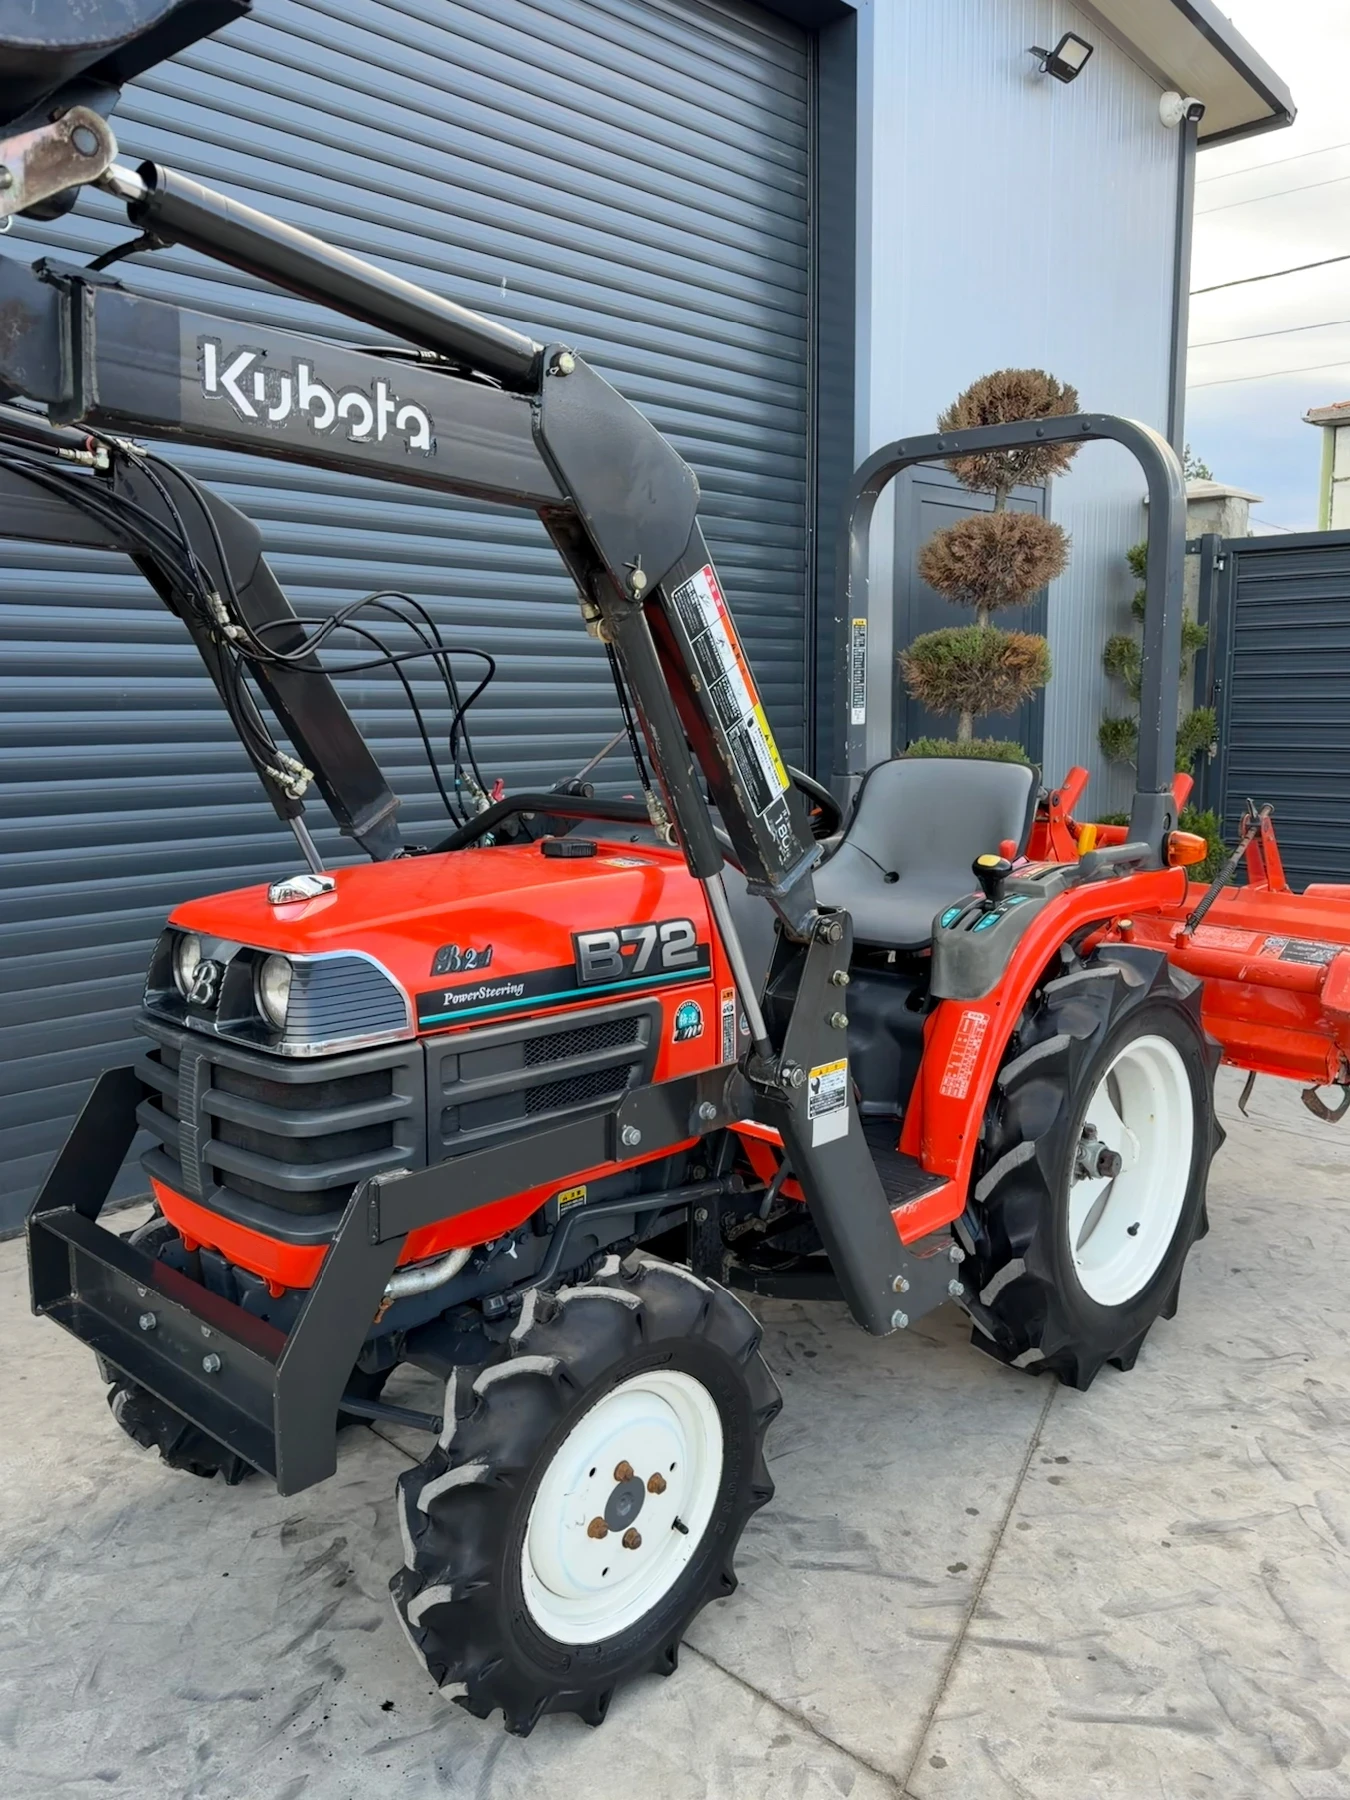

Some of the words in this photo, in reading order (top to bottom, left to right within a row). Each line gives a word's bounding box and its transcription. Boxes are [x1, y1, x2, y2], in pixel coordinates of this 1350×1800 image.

[203, 342, 431, 450] Kubota
[186, 960, 218, 1005] B
[442, 982, 525, 1006] PowerSteering
